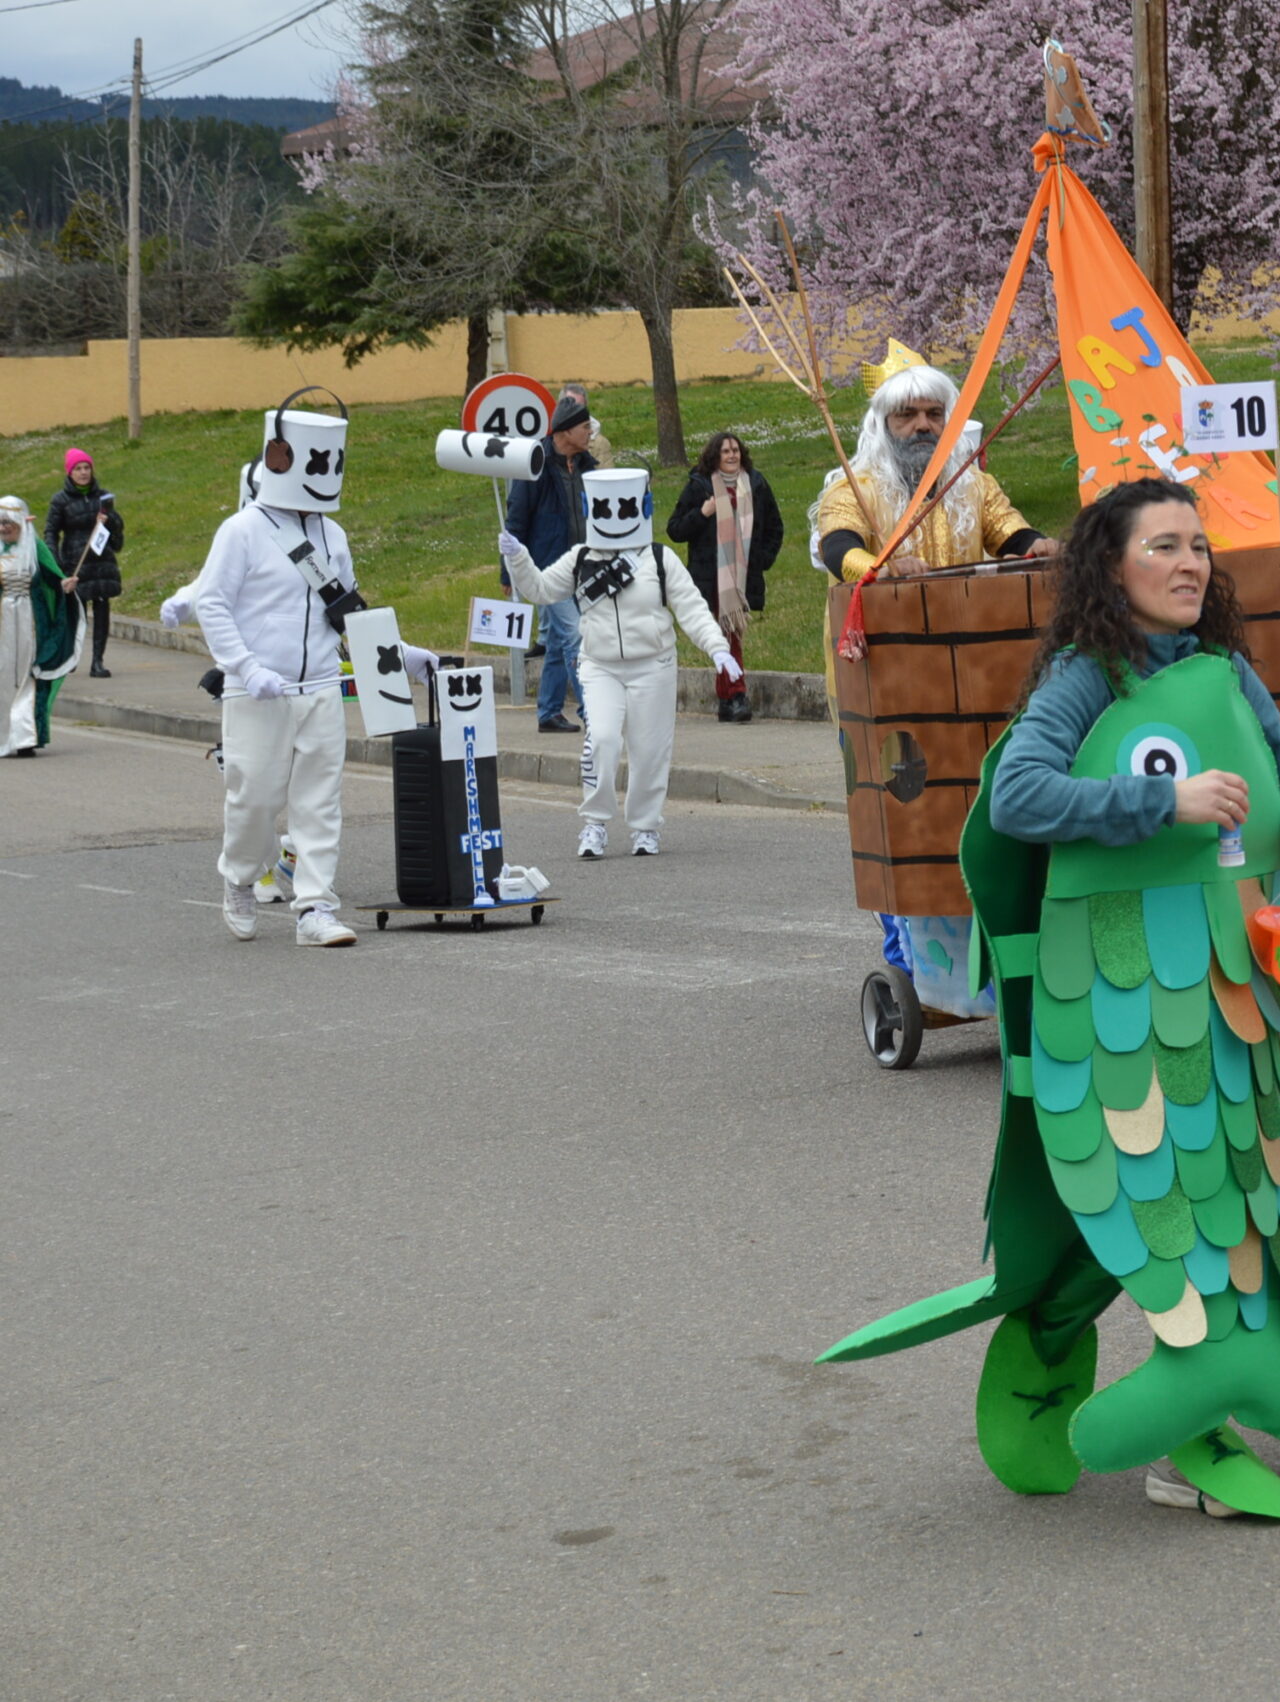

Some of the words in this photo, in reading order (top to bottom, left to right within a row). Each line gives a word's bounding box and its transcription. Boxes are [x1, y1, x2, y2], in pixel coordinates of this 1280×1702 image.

[482, 406, 542, 437] 40
[1230, 395, 1267, 437] 10
[505, 612, 525, 640] 11
[461, 829, 502, 854] FEST
